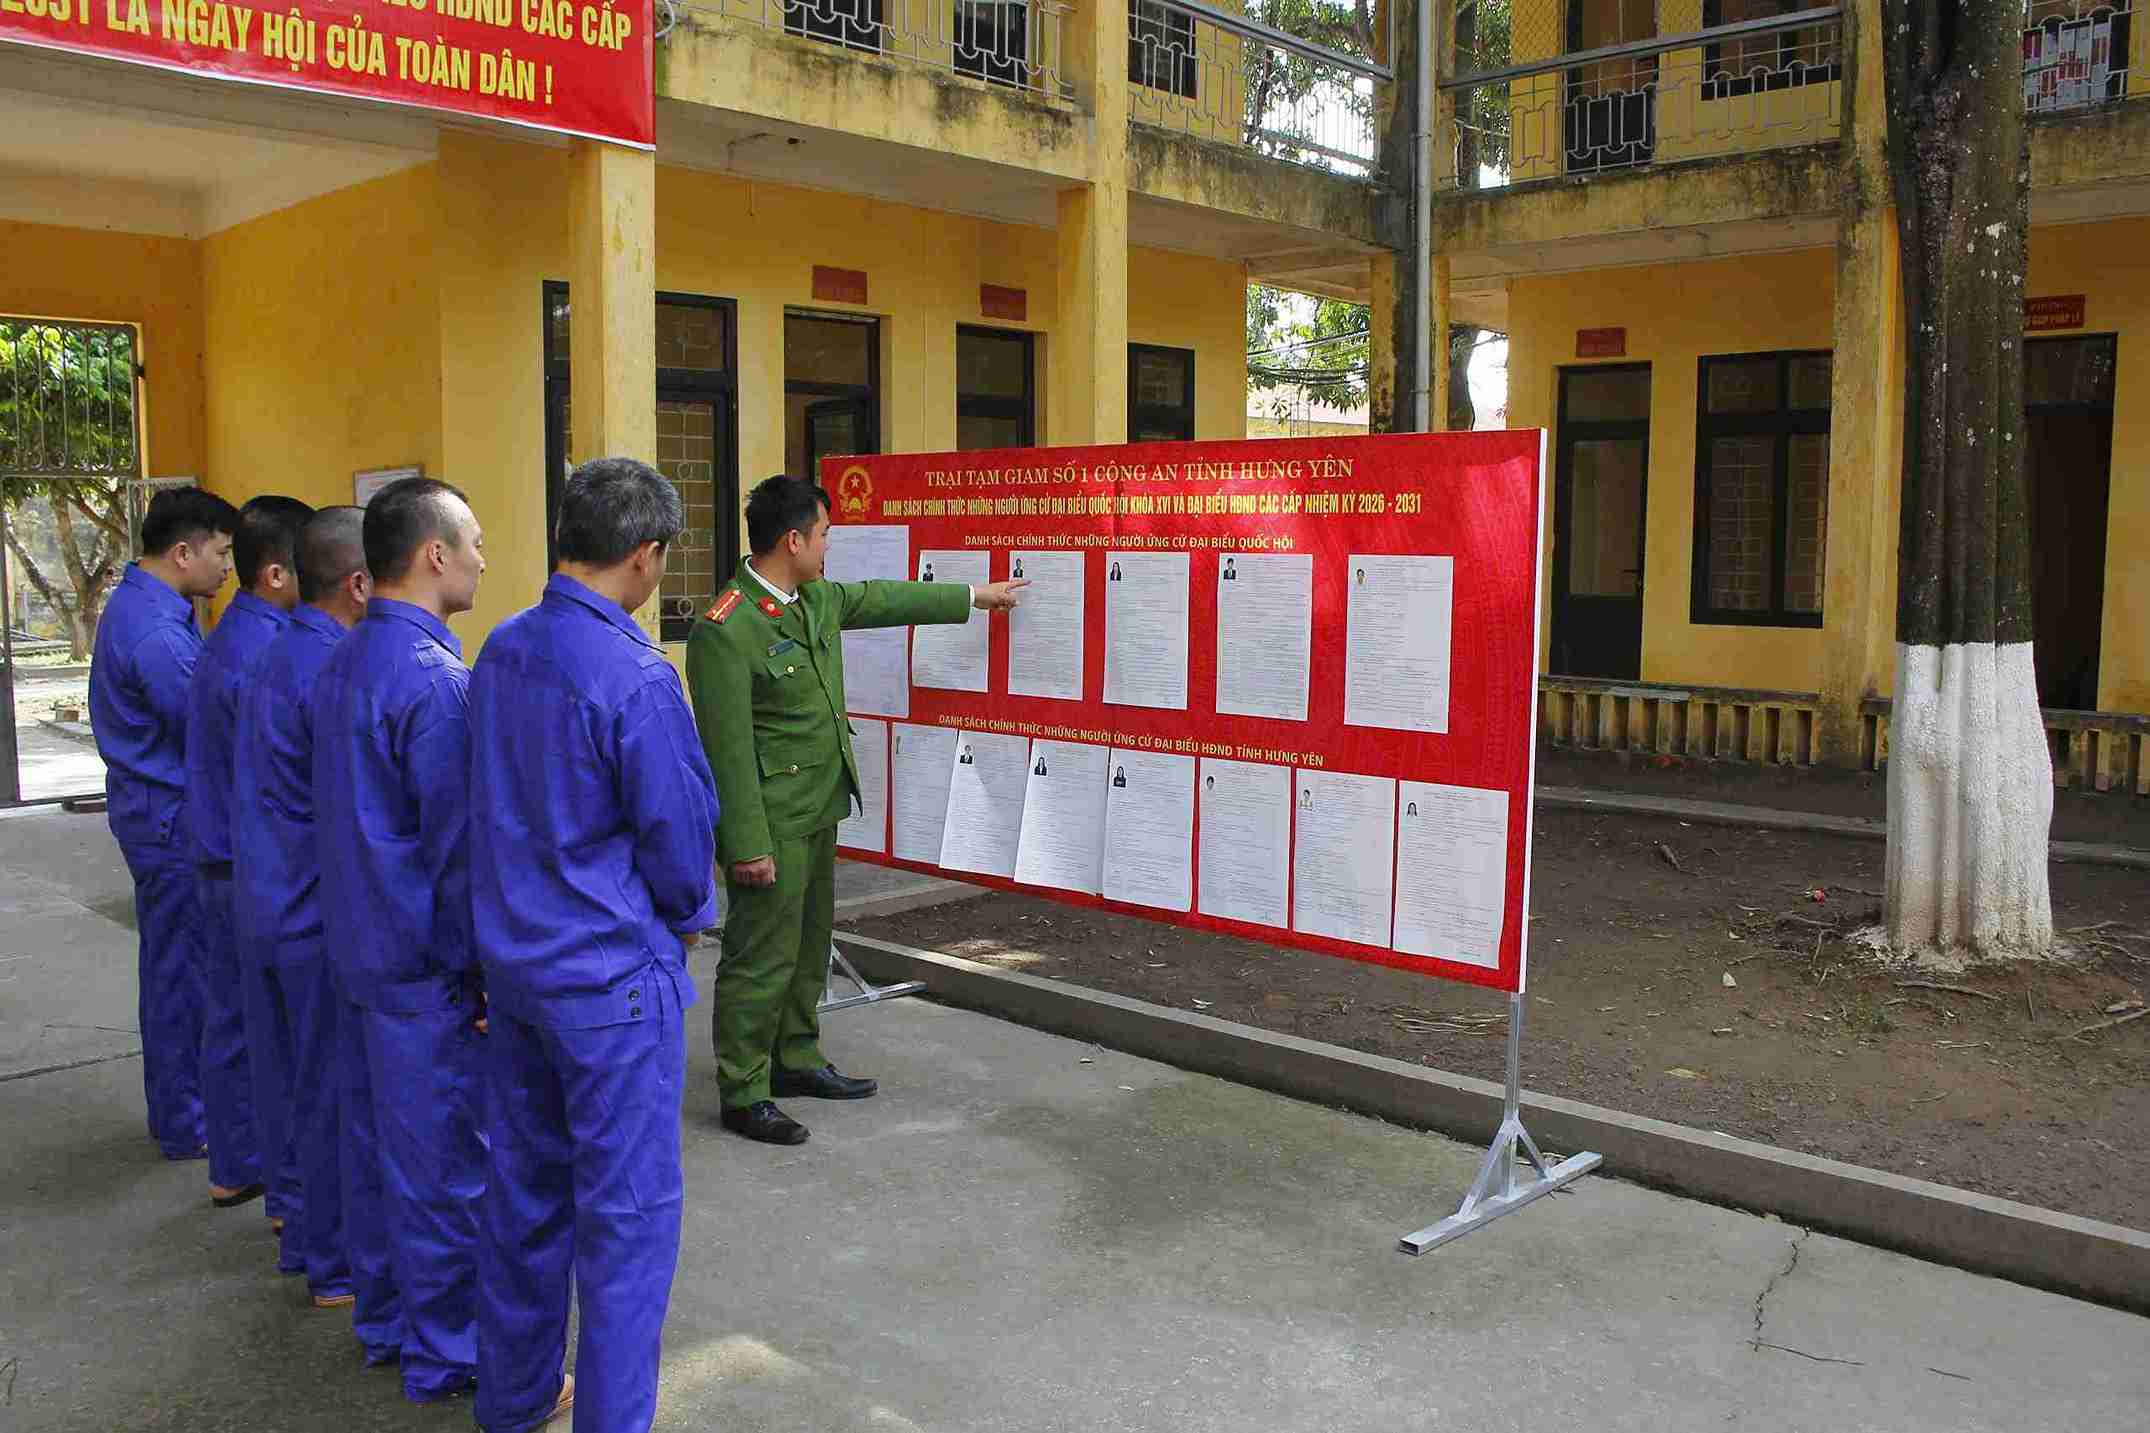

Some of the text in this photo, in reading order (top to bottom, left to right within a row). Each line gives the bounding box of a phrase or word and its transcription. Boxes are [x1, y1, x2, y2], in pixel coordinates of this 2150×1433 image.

[582, 0, 632, 51] CẤP
[263, 8, 316, 72] HỘI
[326, 14, 387, 77] CỦA
[395, 35, 471, 91] TOÀN
[479, 48, 535, 102] DÂN
[545, 65, 553, 104] !
[925, 454, 1354, 490] TRẠI TẠM GIAM SỐ 1 CÔNG AN TỈNH HƯNG YÊN
[1359, 493, 1385, 513] 2026
[1395, 493, 1421, 513] 2031
[965, 532, 1294, 550] DANH SÁCH CHÍNH THỨC NHỮNG NGƯỜI ỨNG CỬ ĐẠI BIỂU QUỐC HỘI
[939, 714, 963, 727] DANH
[964, 715, 987, 729] SÁCH
[988, 718, 1016, 732] CHÍNH
[1018, 721, 1042, 735] THỨC
[1044, 724, 1078, 739] NHỮNG
[1080, 727, 1111, 742] NGƯỜI
[1114, 728, 1135, 745] ỨNG
[1138, 732, 1153, 747] CỬ
[1154, 737, 1173, 752] ĐẠI
[1175, 735, 1199, 753] BIỂU
[1202, 742, 1233, 757] HĐND
[1265, 748, 1299, 764] HƯNG
[1300, 750, 1324, 767] YÊN
